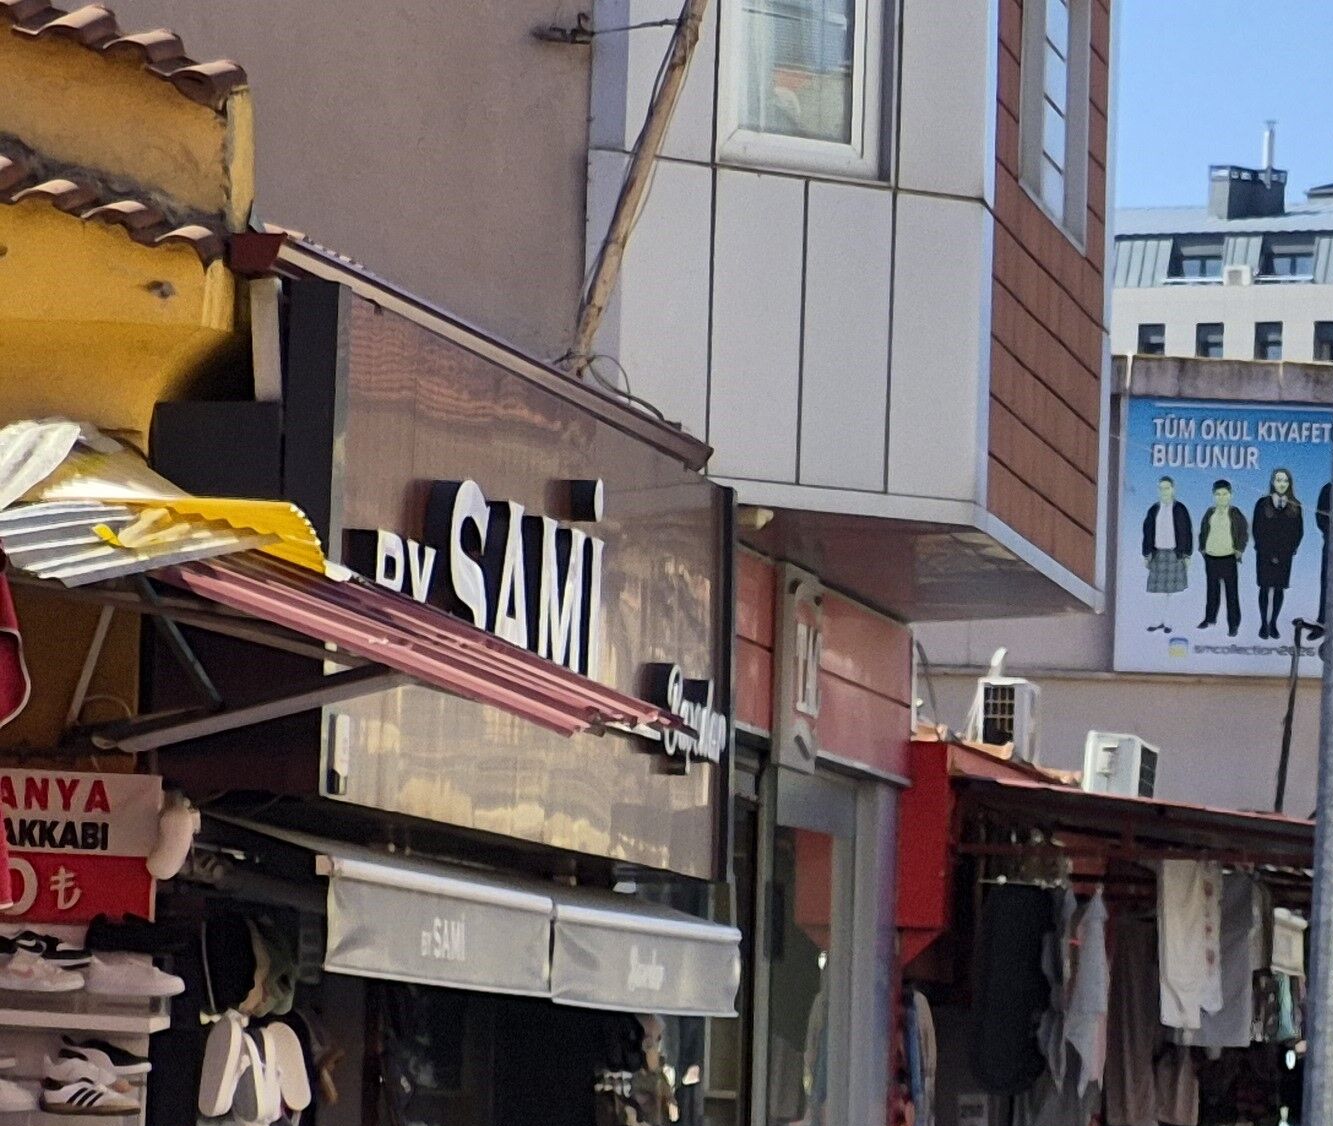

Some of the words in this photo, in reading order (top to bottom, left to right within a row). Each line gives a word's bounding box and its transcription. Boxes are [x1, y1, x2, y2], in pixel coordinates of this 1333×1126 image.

[1152, 413, 1196, 441] TÜM
[1201, 418, 1252, 442] OKUL
[1152, 444, 1261, 471] BULUNUR
